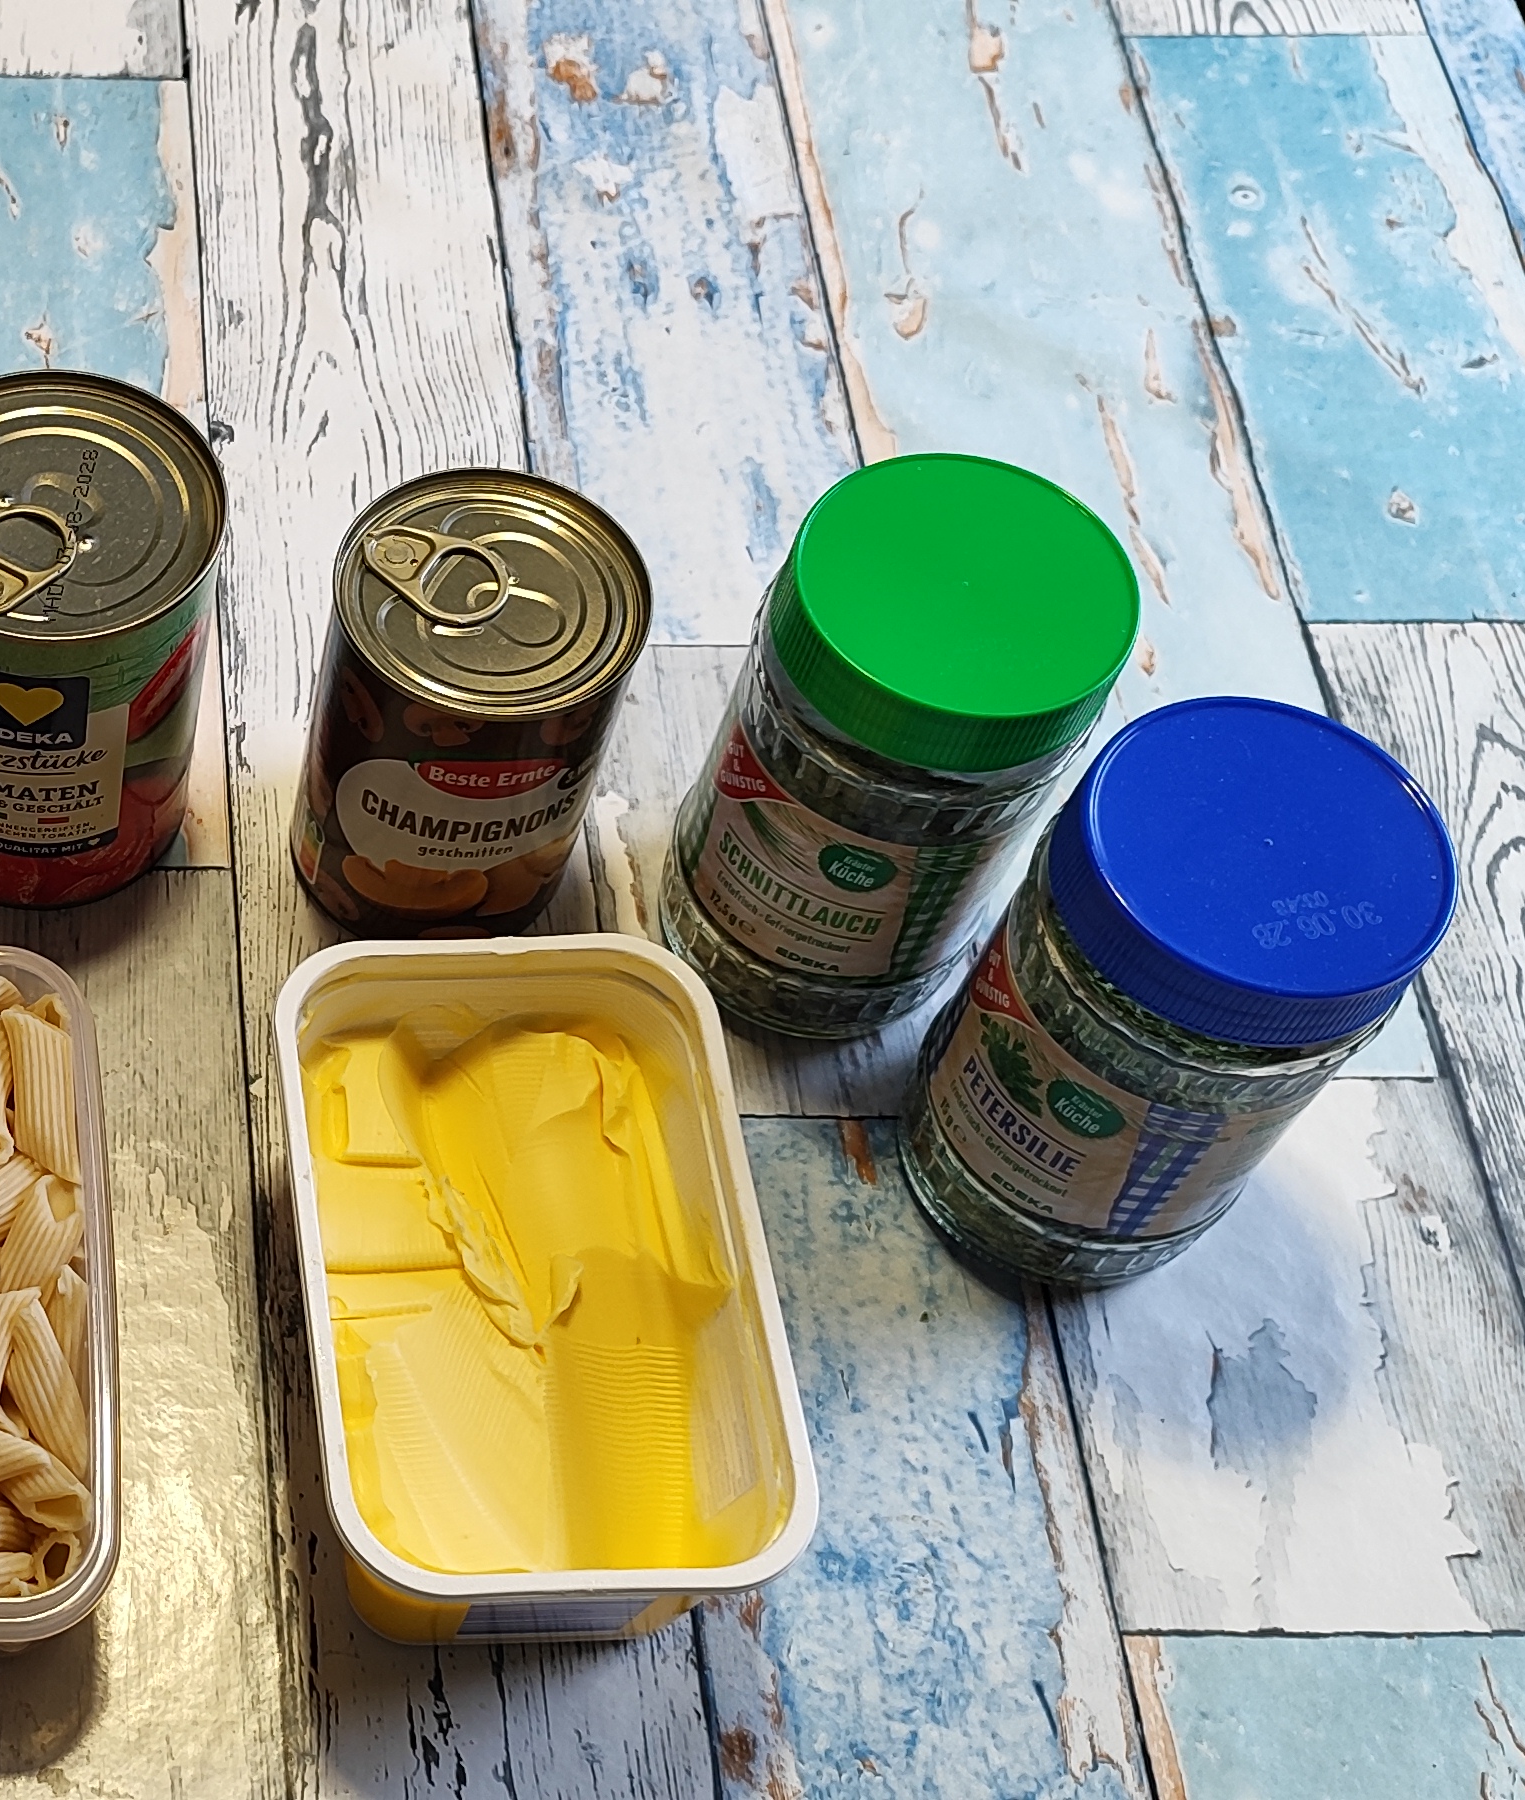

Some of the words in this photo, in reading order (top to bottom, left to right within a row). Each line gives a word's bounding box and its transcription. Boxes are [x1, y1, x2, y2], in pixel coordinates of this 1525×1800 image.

[728, 741, 744, 758] GUT
[428, 765, 490, 788] Beste
[496, 764, 556, 787] Ernte
[361, 788, 579, 843] CHAMPIGNONS
[41, 825, 96, 839] TOMATEN
[62, 843, 83, 853] MIT
[417, 845, 513, 858] geschnitten
[719, 831, 882, 935] SCHNITTLAUCH
[828, 860, 875, 888] Küche
[776, 946, 839, 972] EDEKA
[963, 1055, 1081, 1177] PETERSILIE
[1054, 1097, 1101, 1134] Küche
[991, 1172, 1053, 1214] EDEKA
